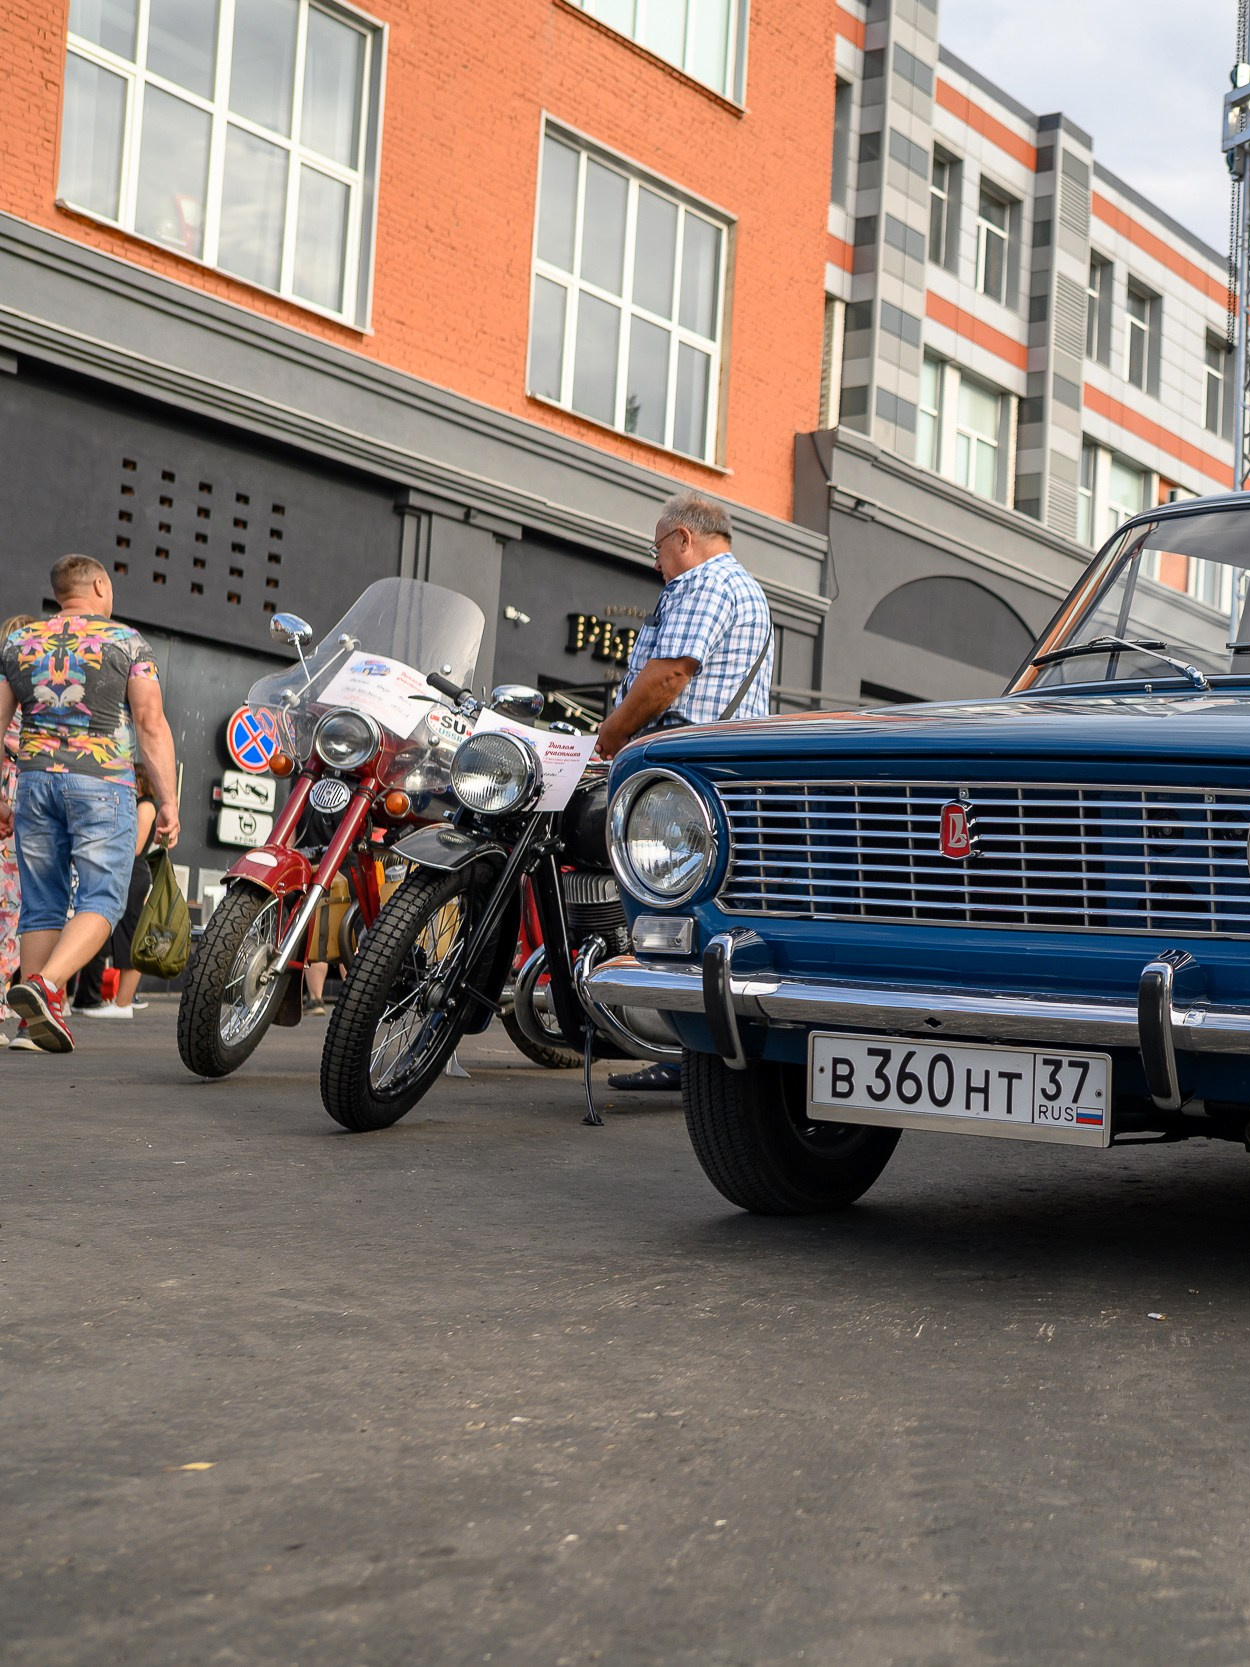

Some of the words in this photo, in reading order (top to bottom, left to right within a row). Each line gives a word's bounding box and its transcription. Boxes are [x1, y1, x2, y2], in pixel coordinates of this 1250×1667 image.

[440, 715, 466, 735] SU
[439, 727, 463, 743] USSR
[548, 741, 575, 750] Диплом
[1040, 1058, 1090, 1103] 37
[1038, 1104, 1074, 1122] RUS
